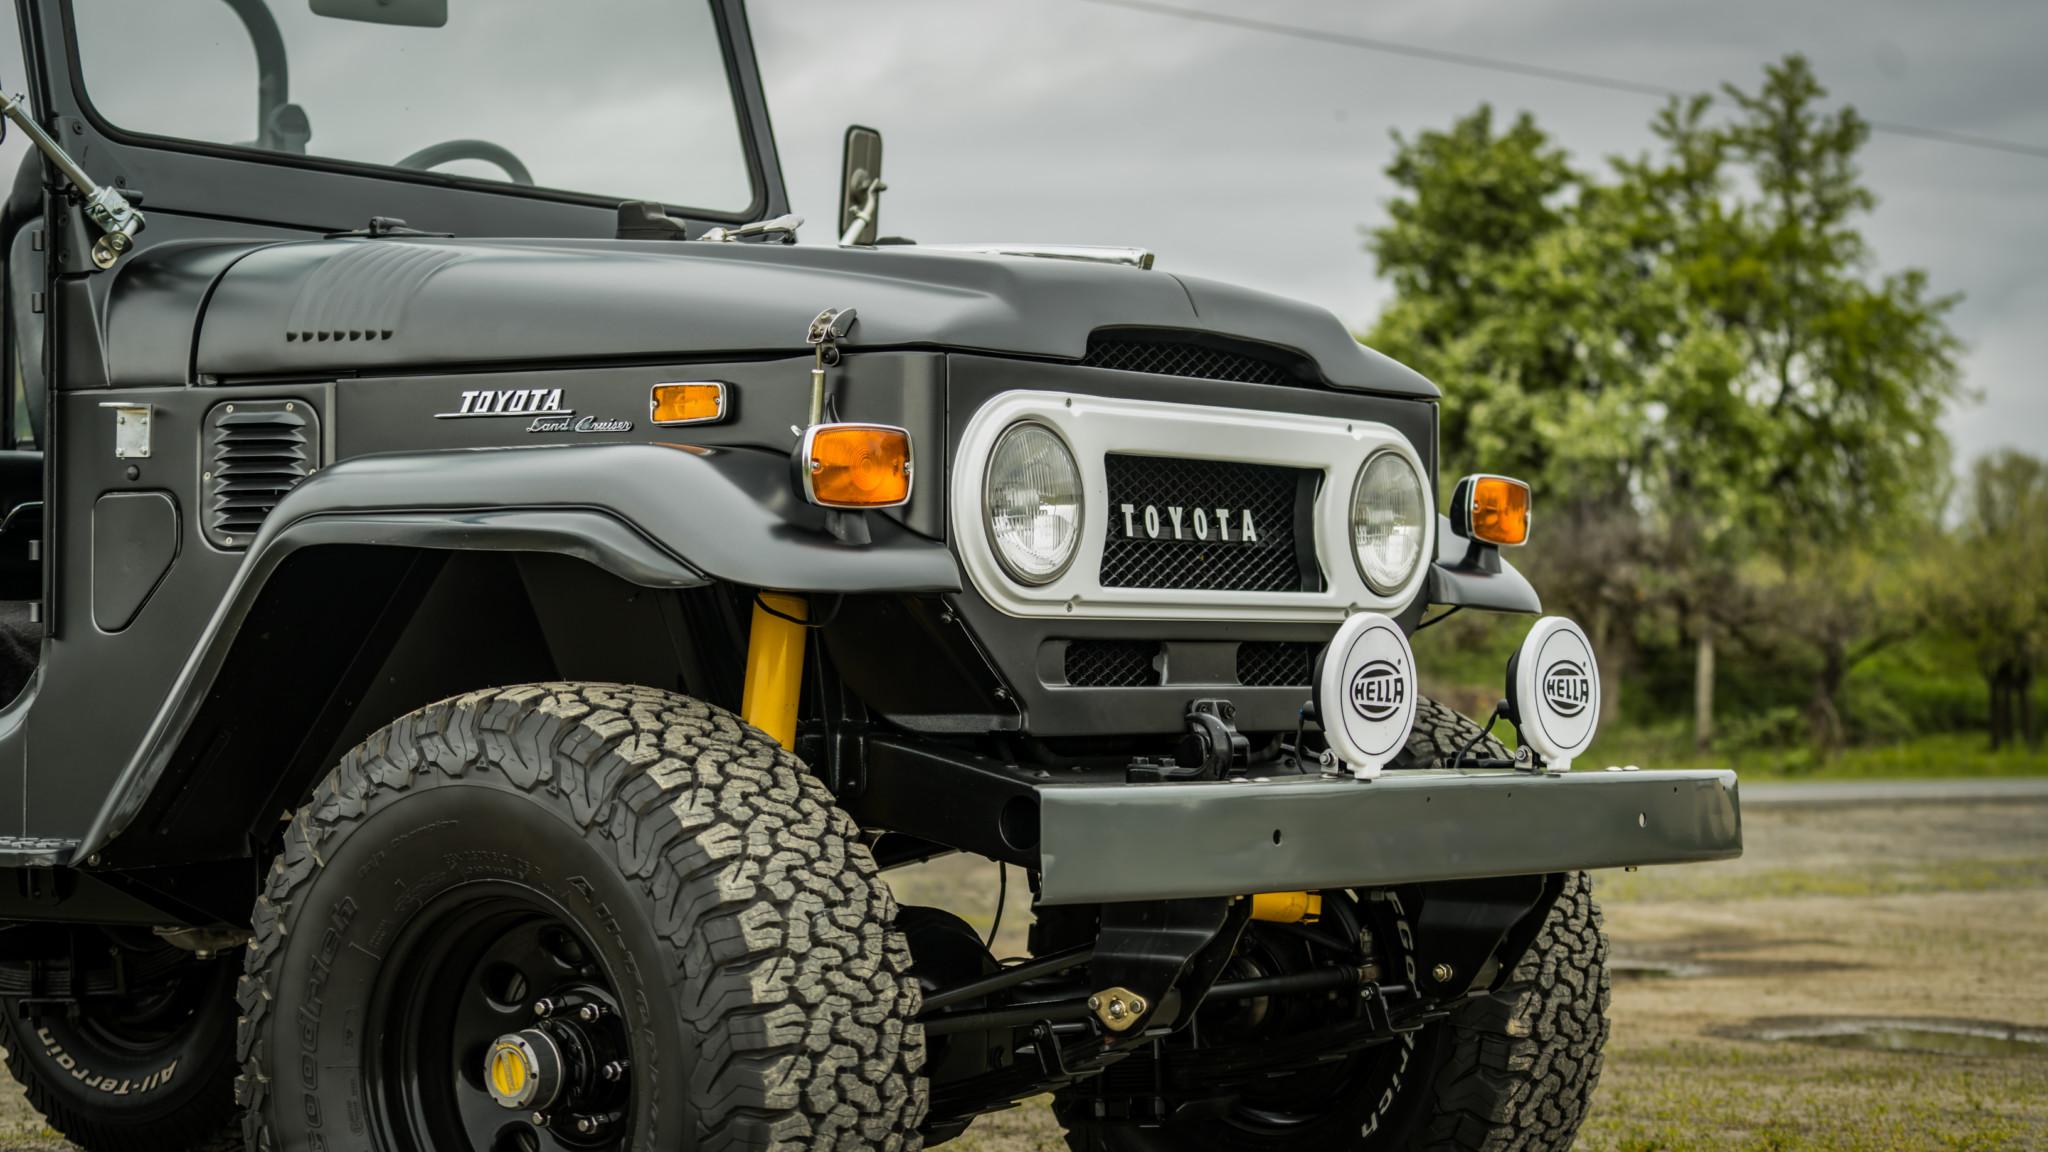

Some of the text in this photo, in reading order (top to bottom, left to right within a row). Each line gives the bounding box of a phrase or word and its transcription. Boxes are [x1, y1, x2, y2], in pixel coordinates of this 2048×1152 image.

[460, 389, 562, 412] TOYOTA
[526, 416, 633, 432] Land Cruiser
[1121, 503, 1257, 541] TOYOTA
[1354, 676, 1404, 704] HELLA
[1547, 675, 1589, 704] HELLA
[37, 1027, 179, 1095] All-Terrain
